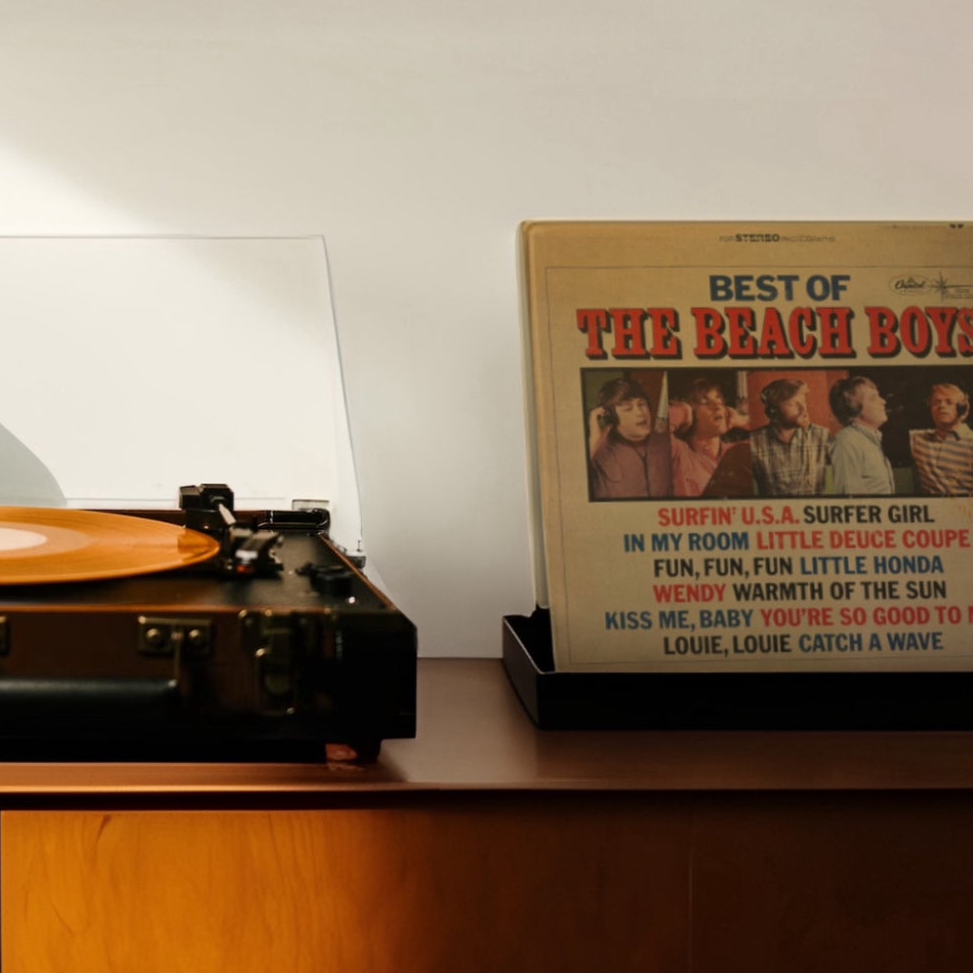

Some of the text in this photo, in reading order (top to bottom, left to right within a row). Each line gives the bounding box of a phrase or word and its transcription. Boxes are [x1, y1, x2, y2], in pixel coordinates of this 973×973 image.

[735, 233, 781, 243] STEREO
[709, 274, 851, 302] BEST OF
[576, 305, 973, 360] THE BEACH BOYS
[658, 504, 935, 526] SURFIN' U.S.A. SURFER GIRL
[623, 528, 971, 553] IN MY ROOM LITTLE DEUCE COUPE
[653, 555, 944, 580] FUN, FUN, FUN LITTLE HONDA
[653, 580, 947, 603] WENDY WARMTH OF THE SUN
[604, 610, 653, 631] KISS
[658, 610, 696, 632] ME,
[699, 608, 753, 629] BABY
[759, 607, 833, 628] YOU'RE
[839, 606, 867, 626] SO
[872, 605, 930, 626] GOOD
[934, 605, 962, 625] TO
[663, 631, 944, 657] LOUIE, LOUIE CATCH A WAVE
